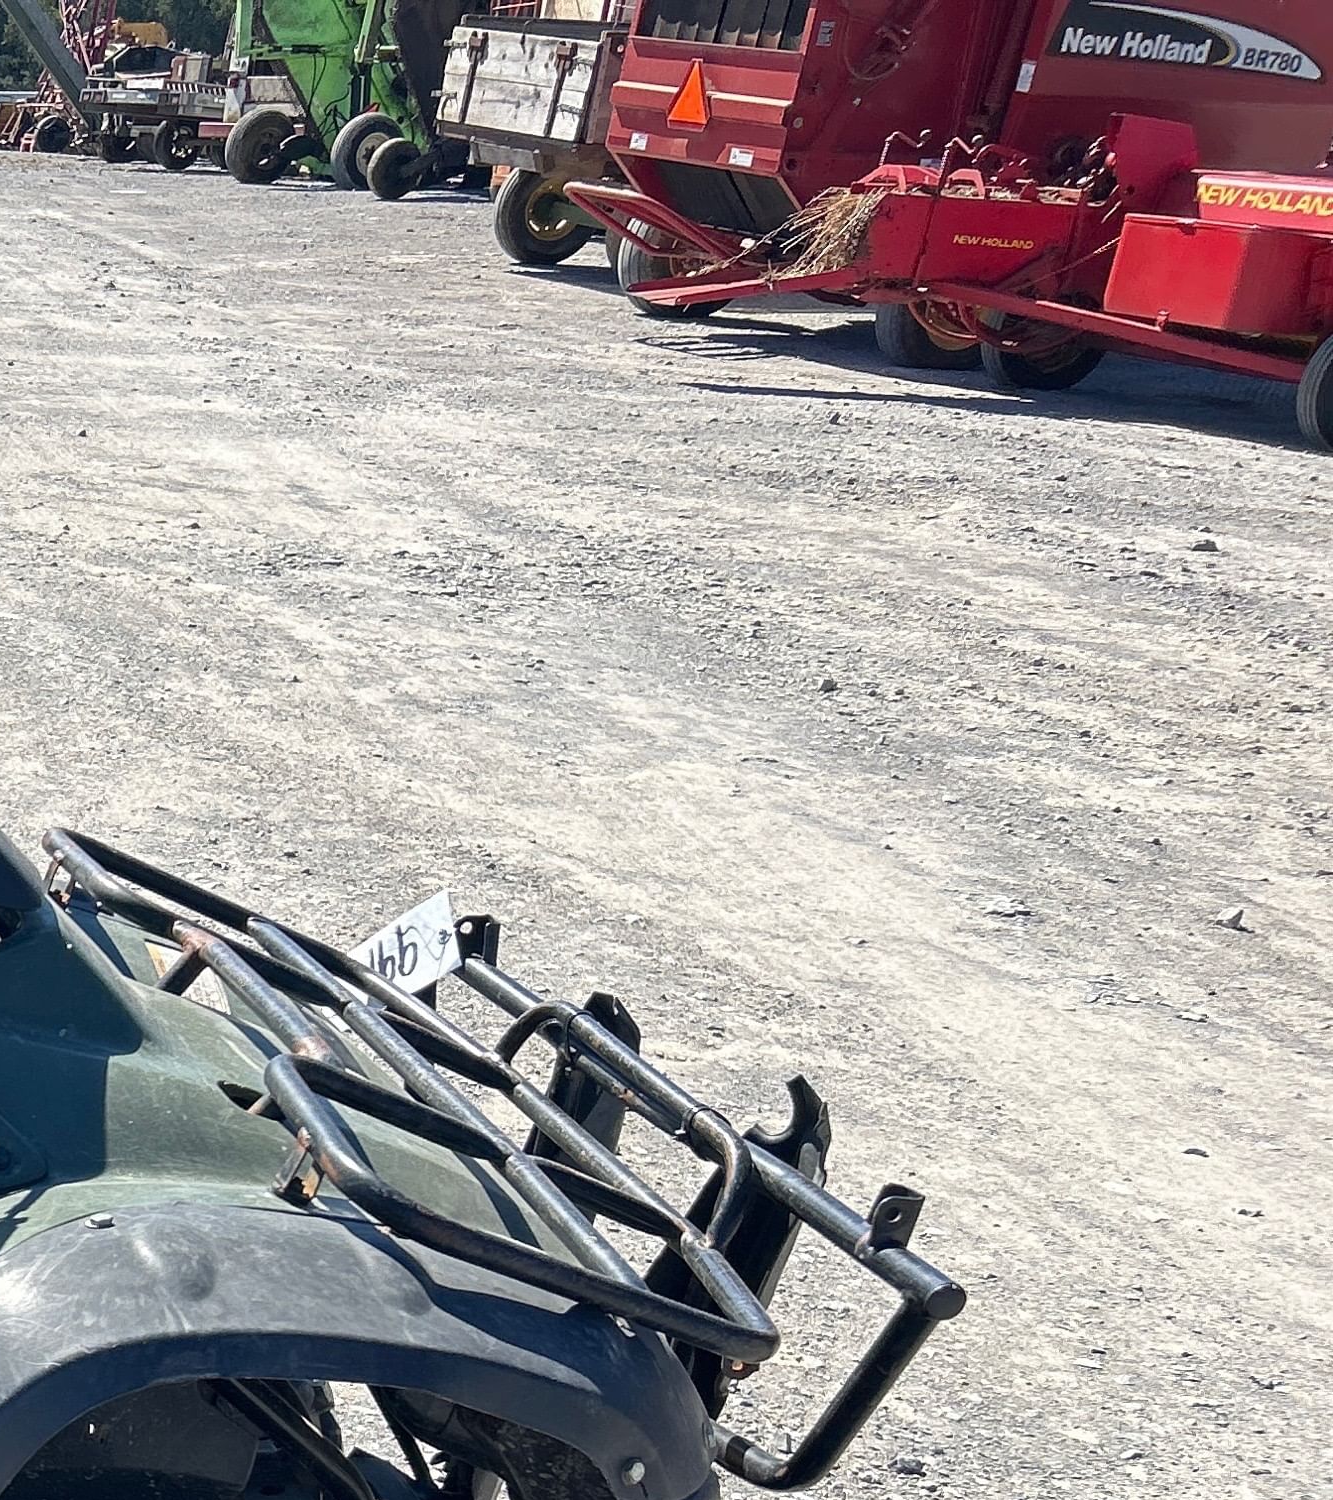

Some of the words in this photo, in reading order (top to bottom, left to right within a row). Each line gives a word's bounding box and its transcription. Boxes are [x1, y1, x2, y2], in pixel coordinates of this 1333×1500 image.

[1060, 26, 1118, 55] New
[1120, 31, 1213, 65] Holland
[1241, 47, 1302, 73] BR780
[1197, 184, 1242, 206] NEW
[952, 234, 982, 245] NEW
[980, 236, 1034, 250] HOLLAND
